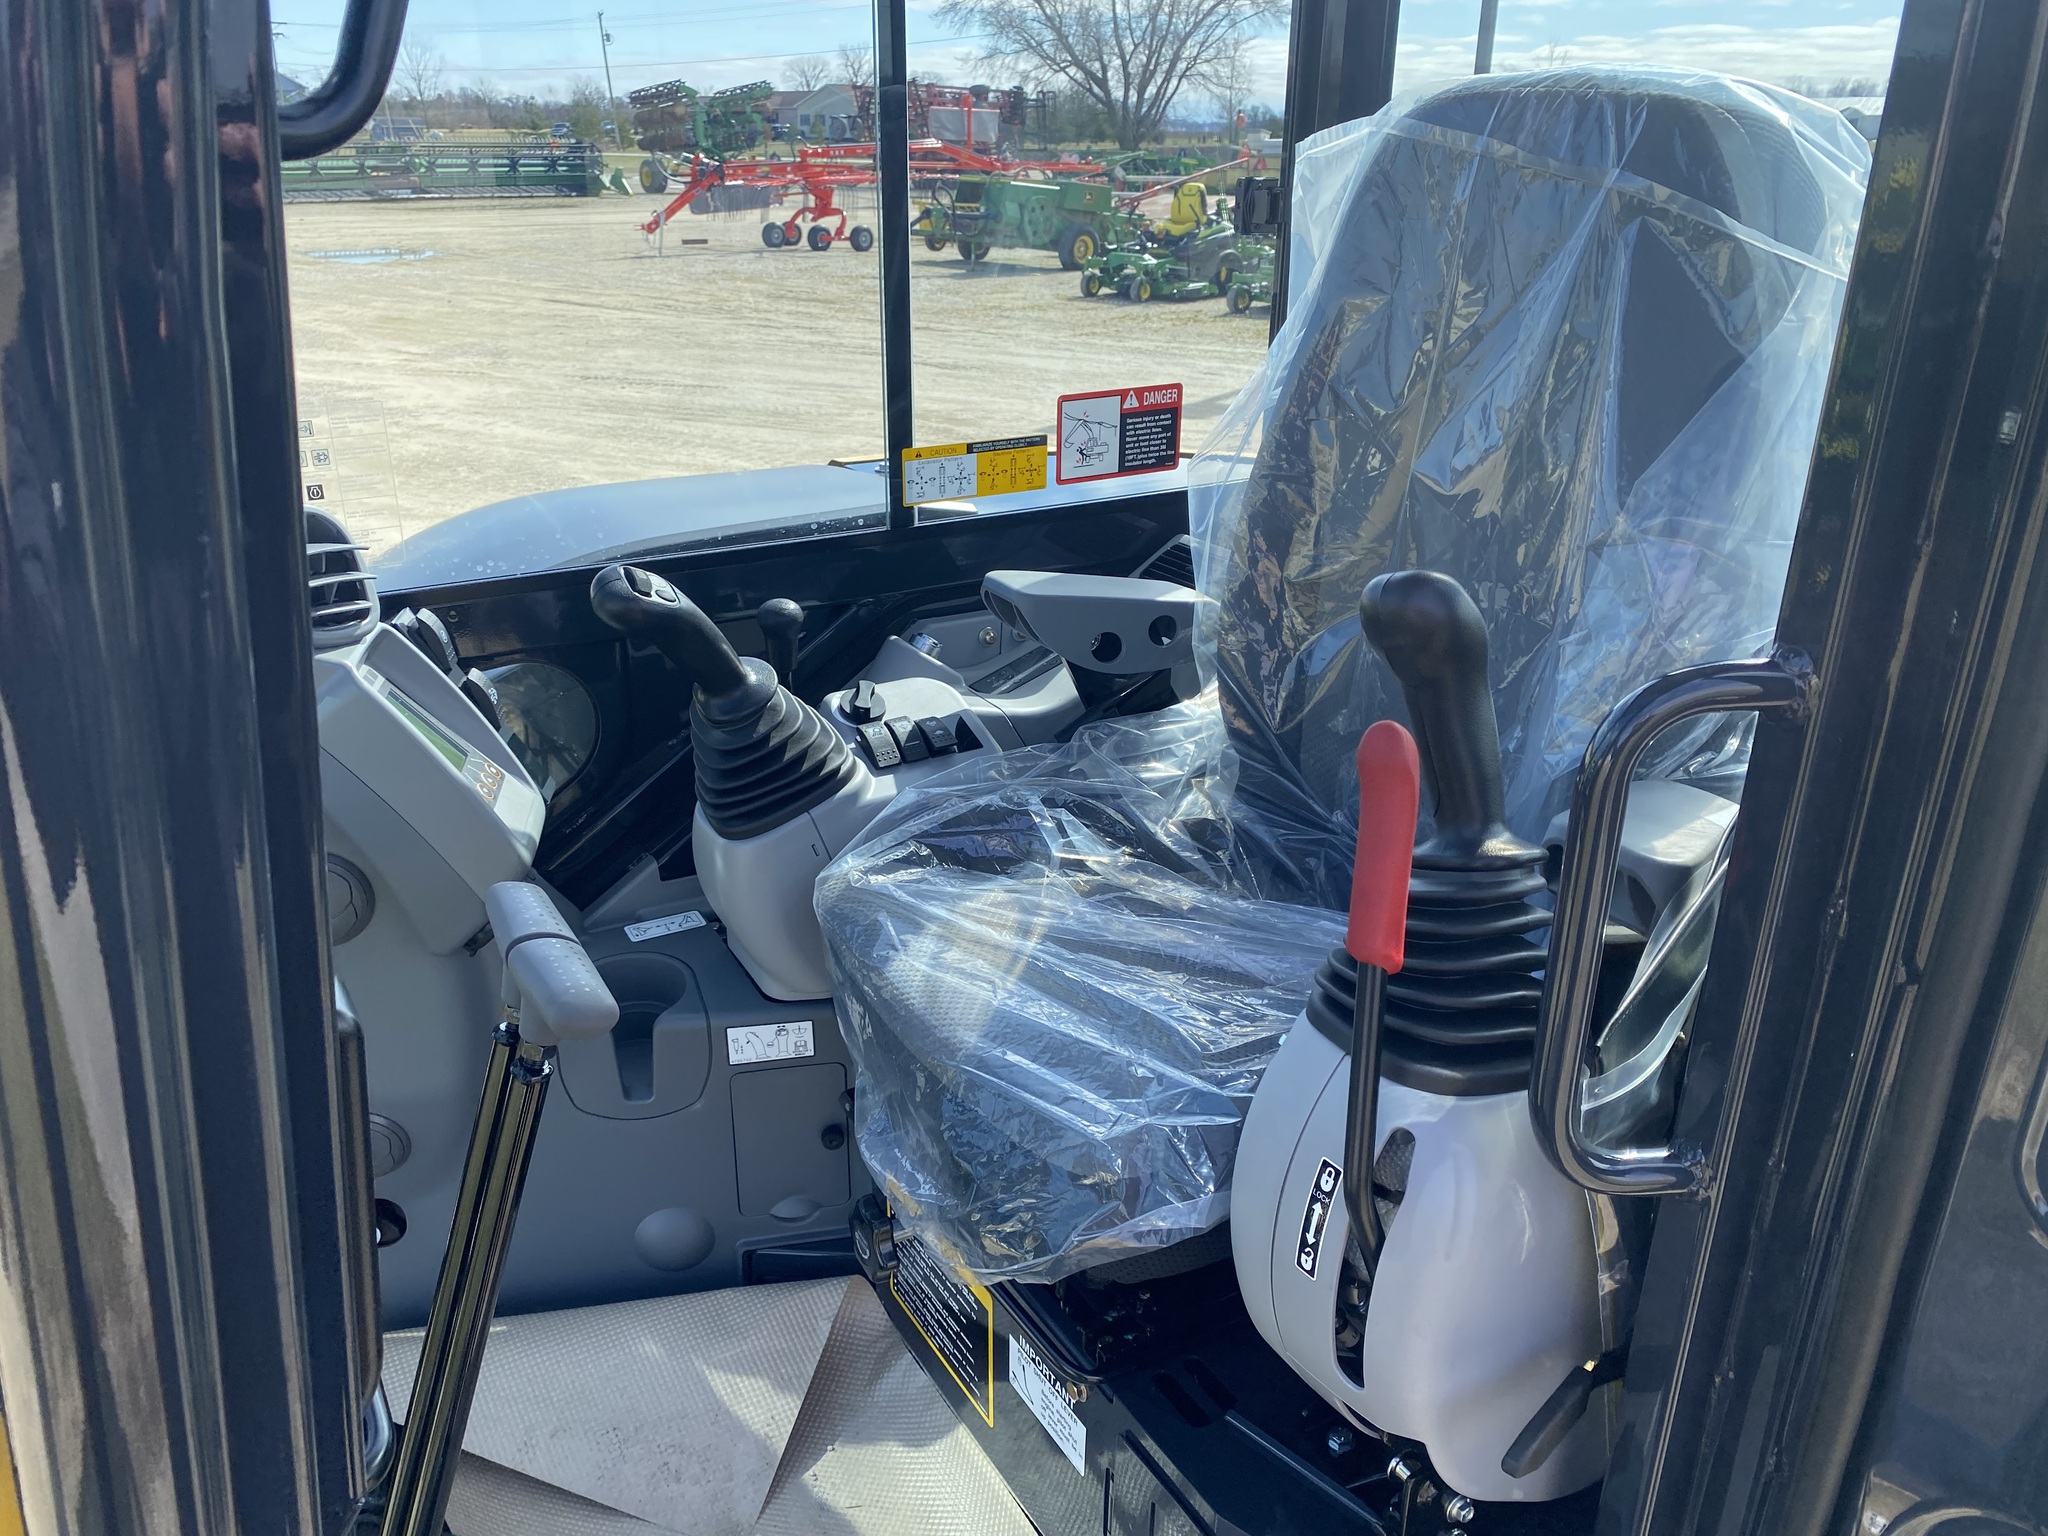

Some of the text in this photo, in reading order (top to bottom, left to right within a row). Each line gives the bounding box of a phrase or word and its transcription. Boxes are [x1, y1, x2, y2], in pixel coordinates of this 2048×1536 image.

[1144, 389, 1178, 406] DANGER
[930, 448, 957, 456] CAUTION
[1313, 1188, 1330, 1206] LOCK
[1020, 1334, 1076, 1410] IMPORTANT
[1018, 1348, 1078, 1426] PILOT SHUT OFF LEVER
